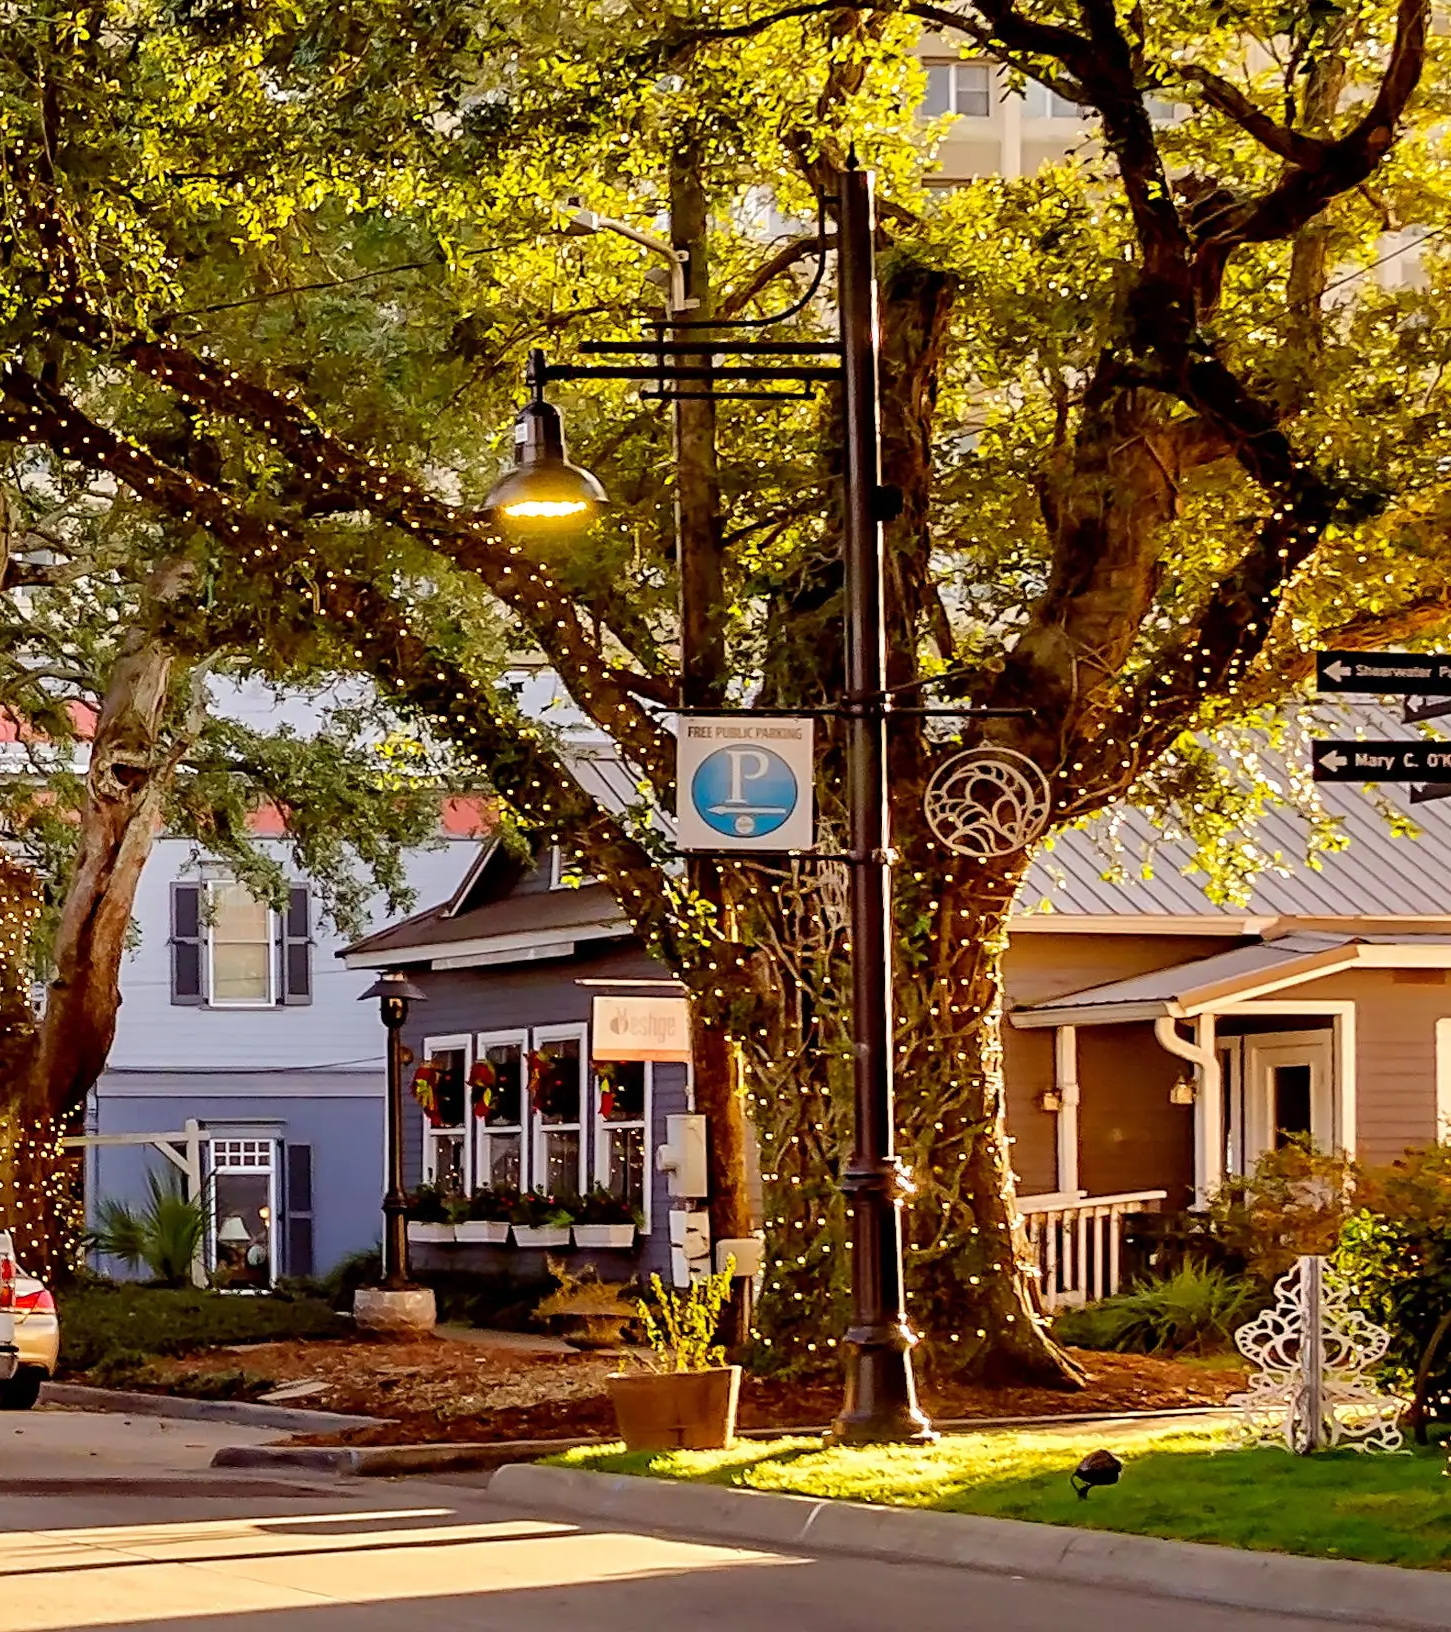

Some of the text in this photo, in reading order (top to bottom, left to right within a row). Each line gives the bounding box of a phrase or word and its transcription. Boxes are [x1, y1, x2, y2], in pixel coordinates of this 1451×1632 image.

[687, 726, 803, 740] FREE PUBLIC PARKING
[1355, 753, 1396, 771] Mary
[726, 750, 769, 804] P
